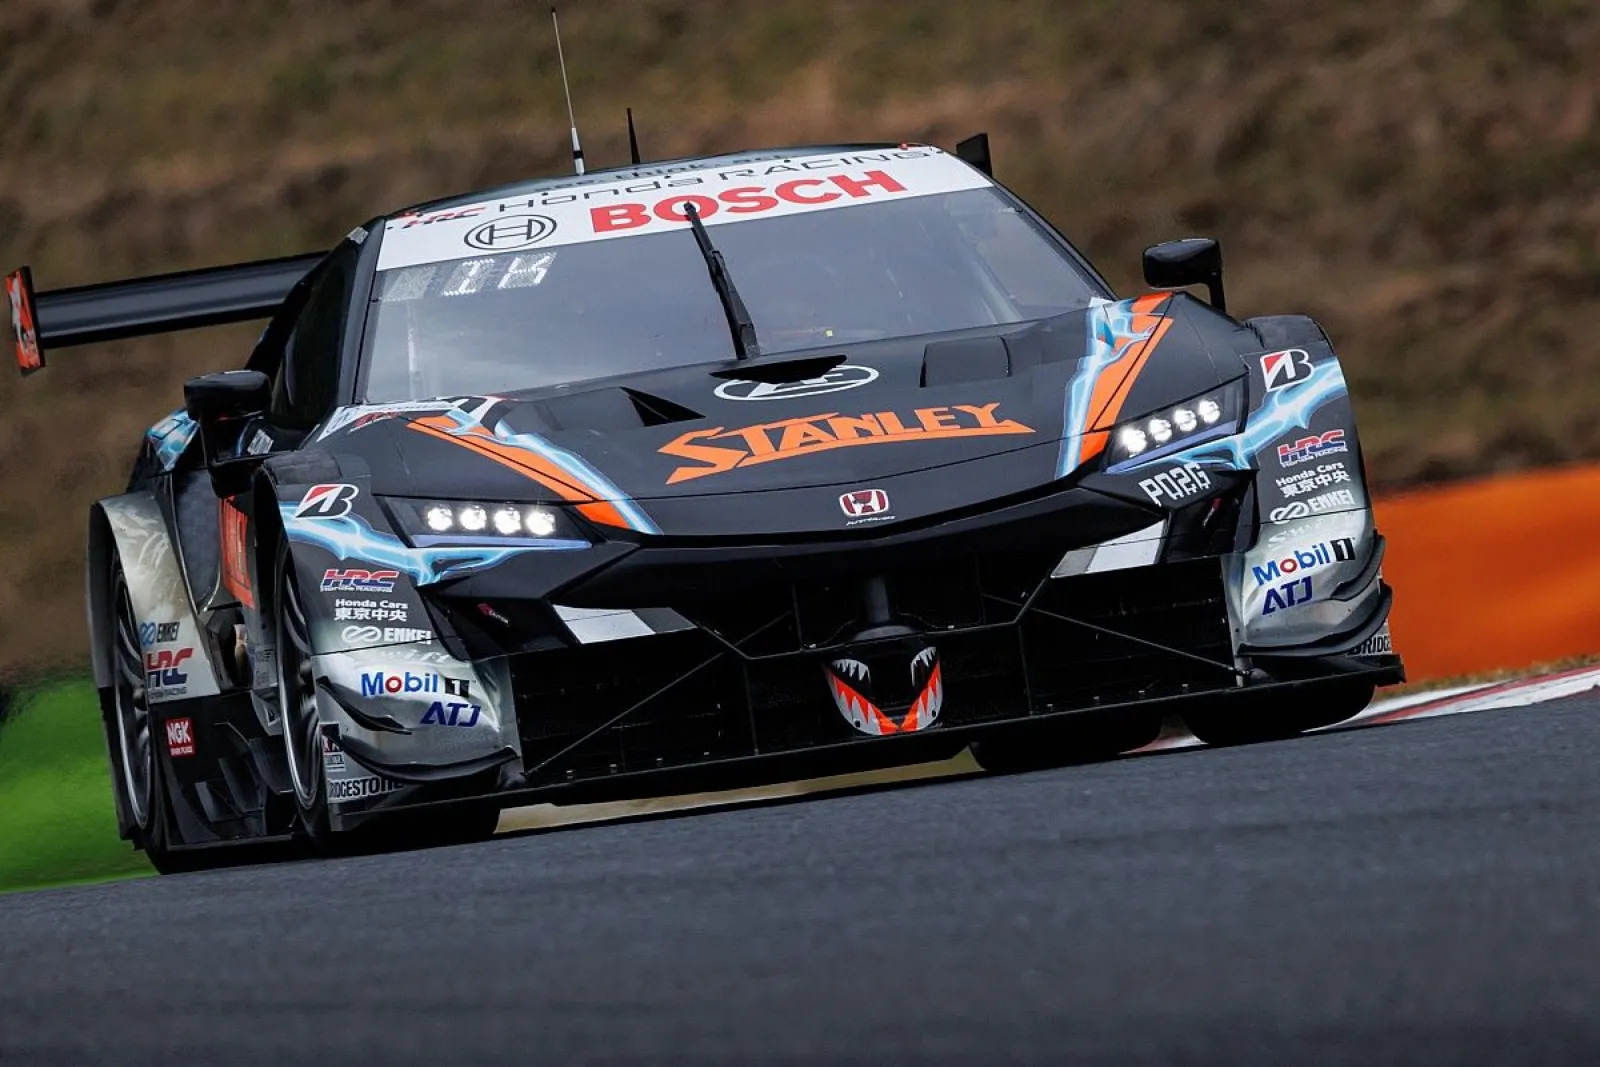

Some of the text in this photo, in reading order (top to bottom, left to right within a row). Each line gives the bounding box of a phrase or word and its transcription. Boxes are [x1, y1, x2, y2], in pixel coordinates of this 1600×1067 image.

[499, 148, 930, 212] Honda RACING
[589, 170, 908, 233] BOSCH
[656, 402, 1036, 485] STANLEY
[1277, 429, 1346, 465] HRC
[1275, 462, 1345, 487] Honda Cars
[1280, 470, 1351, 498] 東京中央
[1307, 488, 1356, 512] ENKEI
[1252, 543, 1331, 586] Mobil
[322, 568, 399, 590] HRC
[335, 598, 409, 609] Honda Cars
[1262, 576, 1313, 616] ATJ
[334, 608, 408, 622] 東京中央
[384, 627, 432, 645] ENKEI
[361, 671, 439, 697] Mobil
[420, 701, 482, 728] ATJ
[166, 720, 192, 745] NGK
